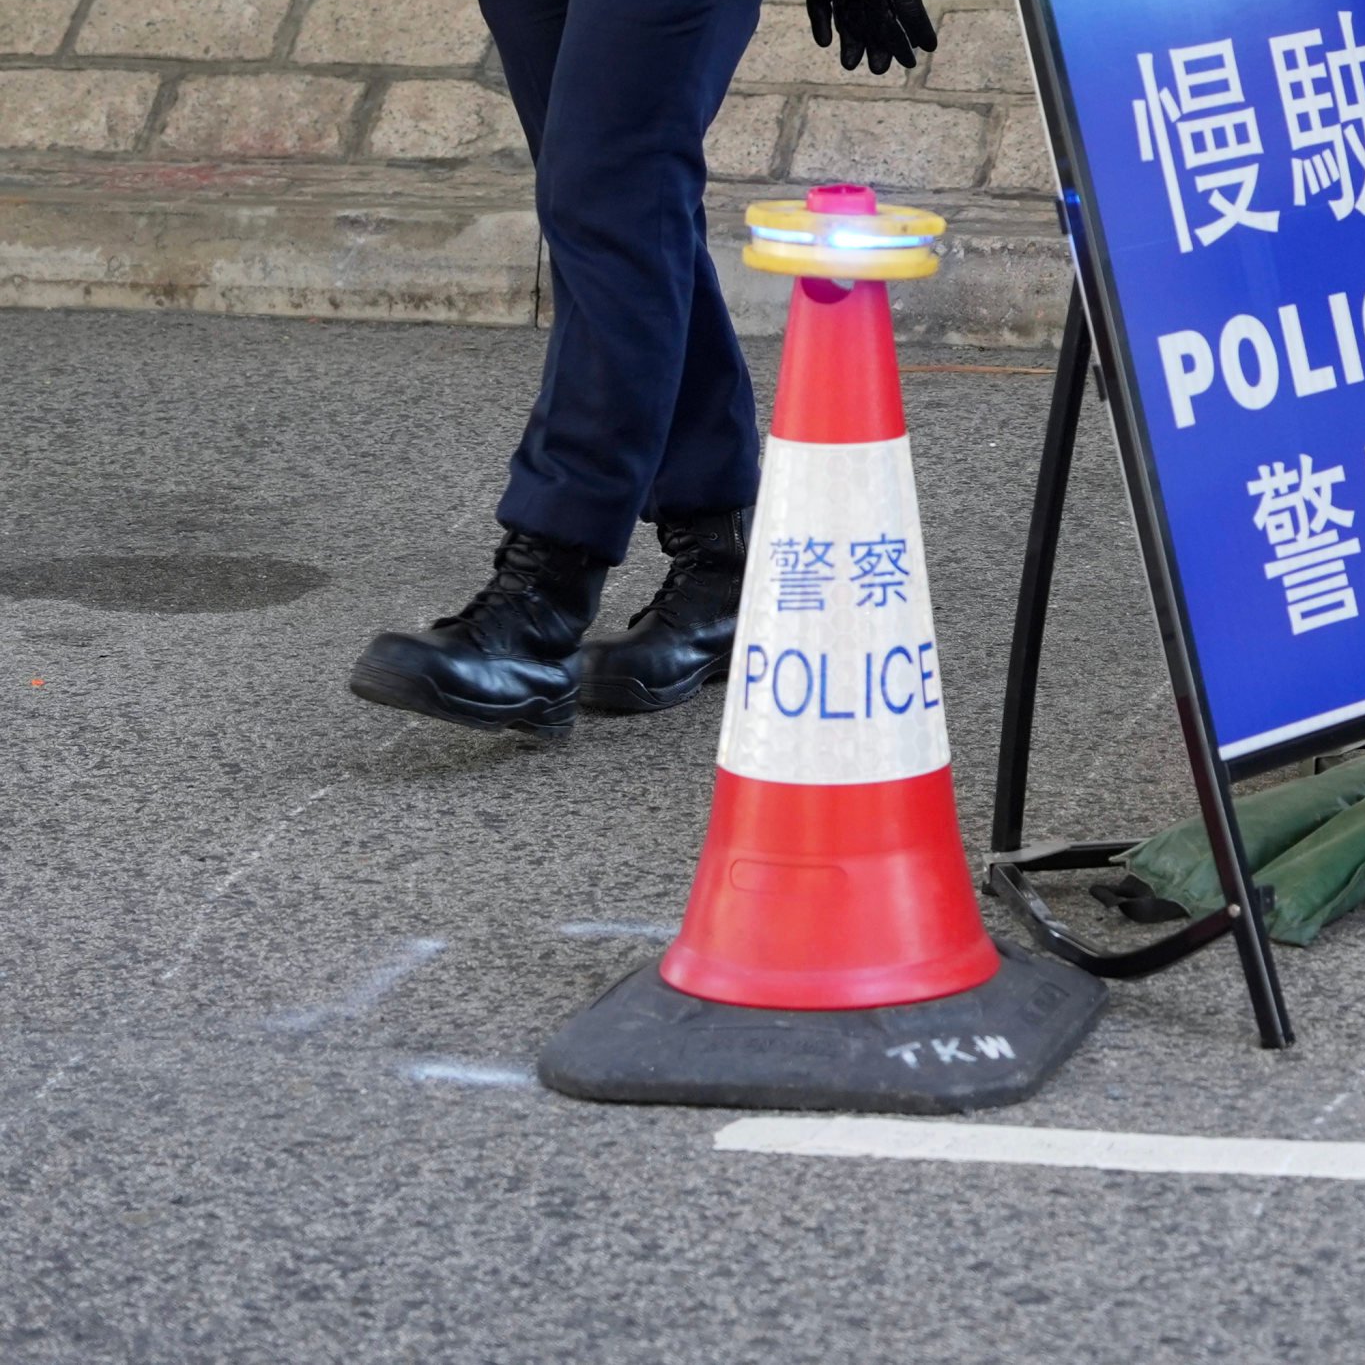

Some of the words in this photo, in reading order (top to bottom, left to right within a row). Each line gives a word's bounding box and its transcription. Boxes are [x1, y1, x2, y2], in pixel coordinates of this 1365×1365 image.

[769, 532, 911, 612] 警察
[744, 641, 939, 719] POLICE
[886, 1034, 1017, 1069] TKW
